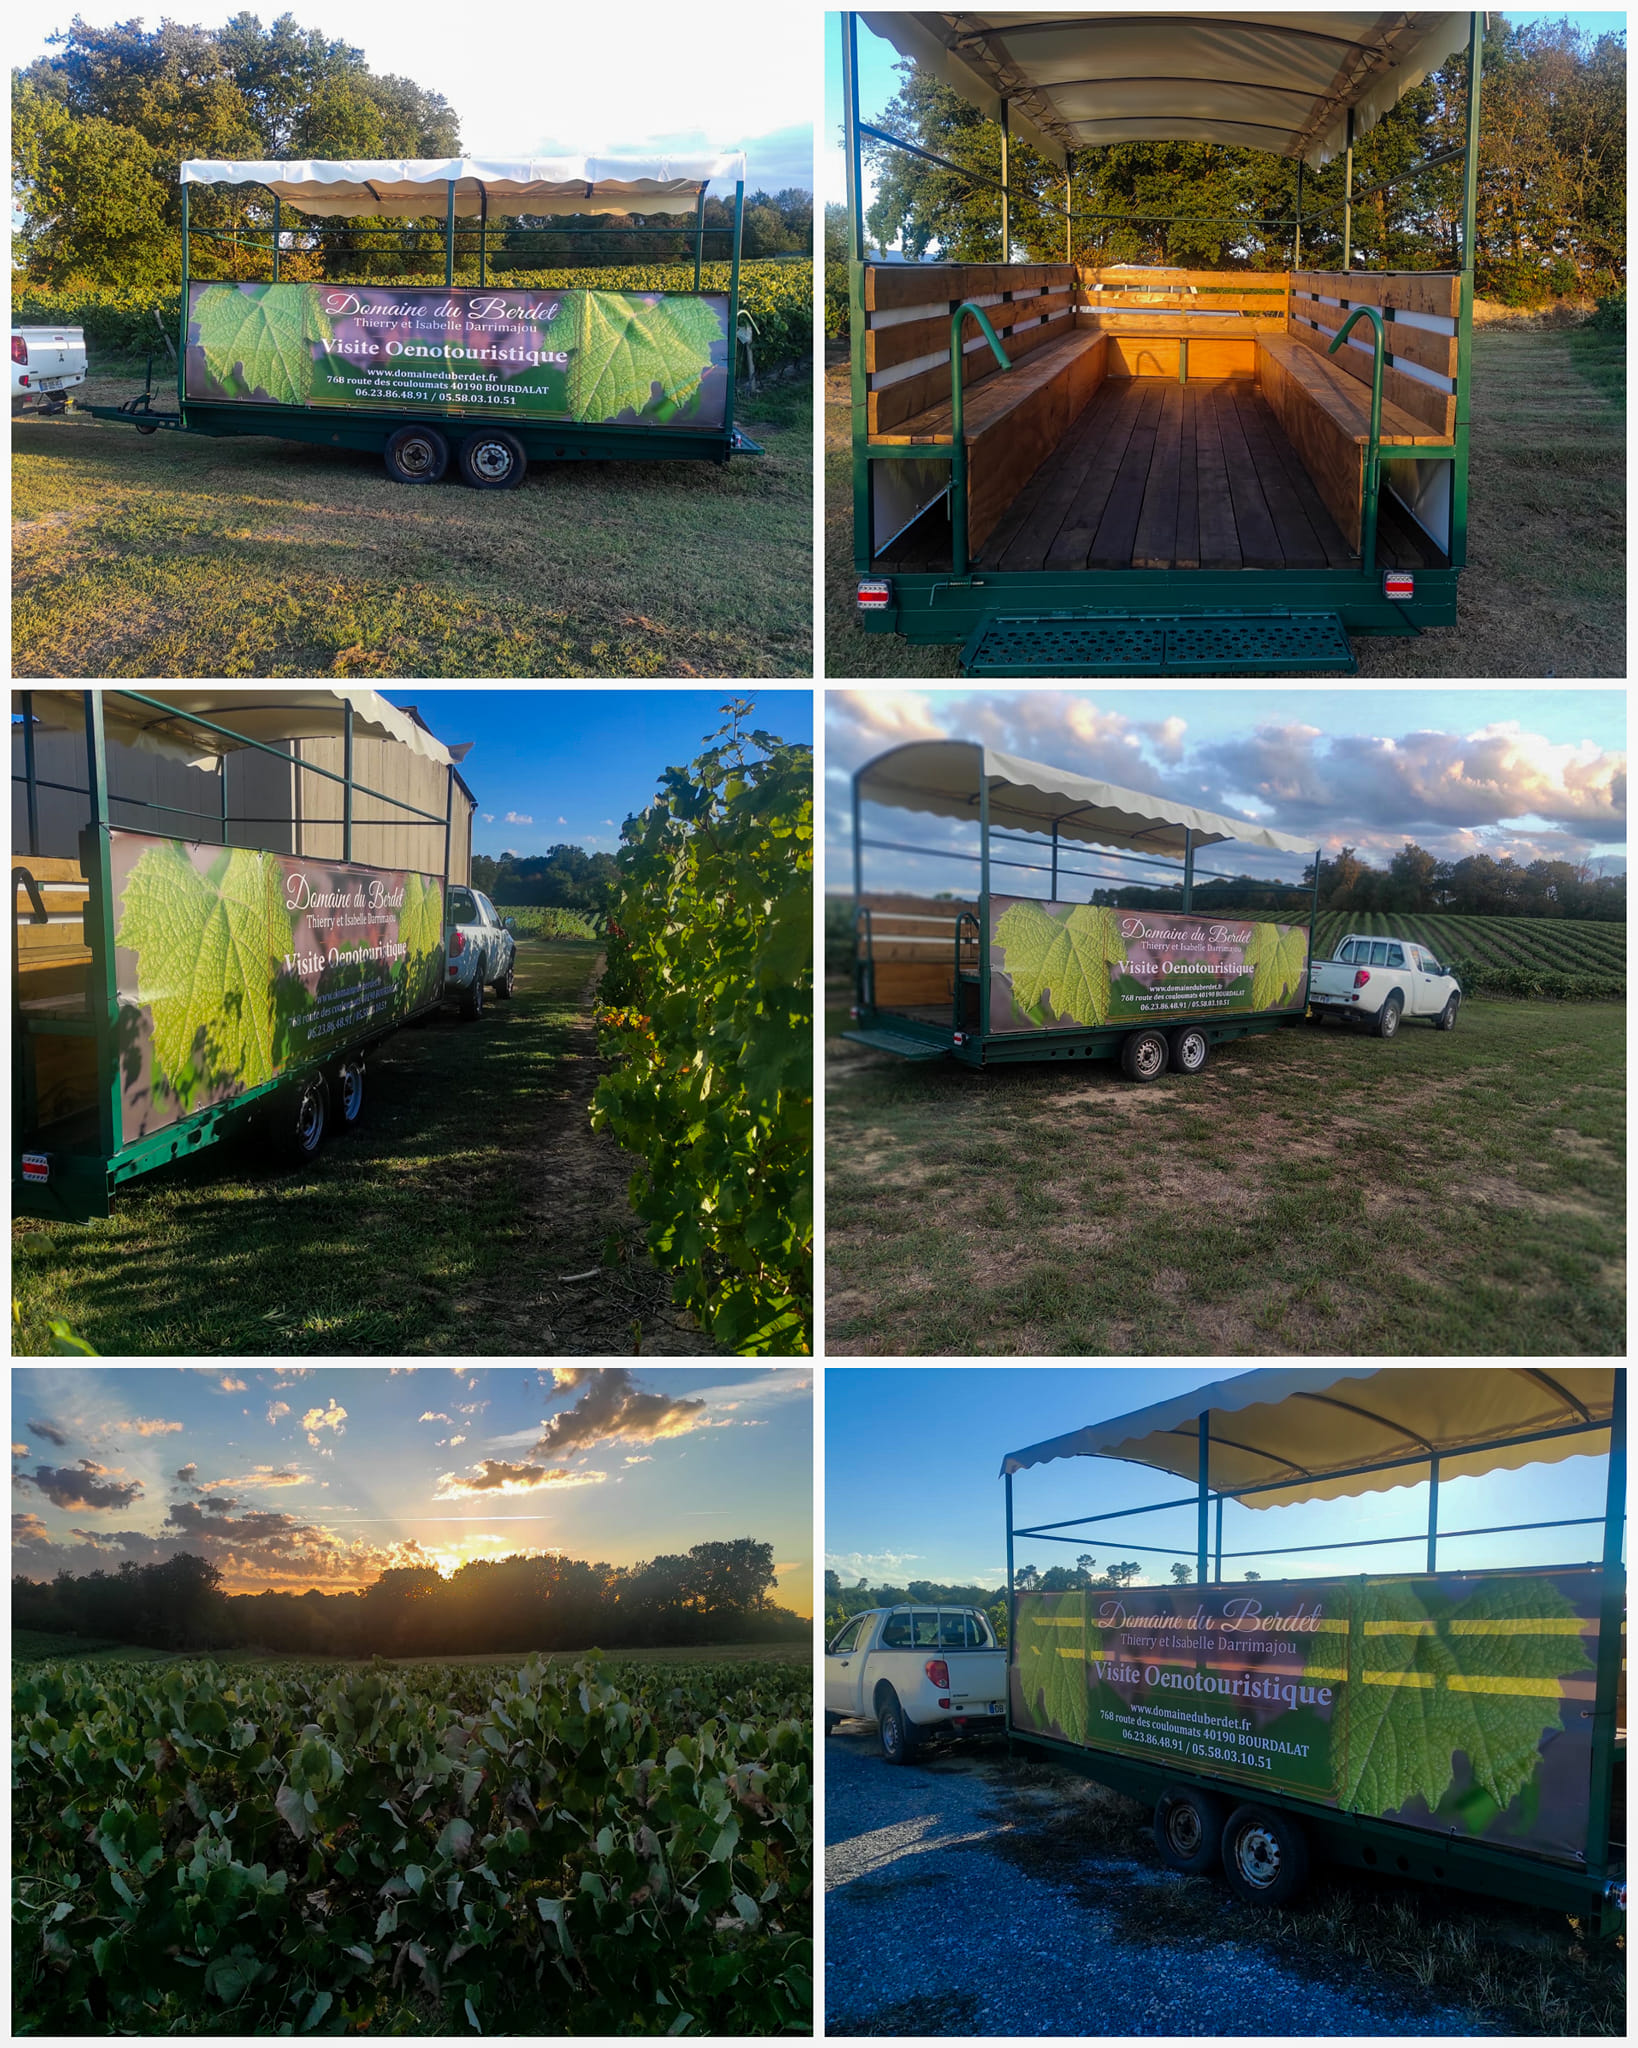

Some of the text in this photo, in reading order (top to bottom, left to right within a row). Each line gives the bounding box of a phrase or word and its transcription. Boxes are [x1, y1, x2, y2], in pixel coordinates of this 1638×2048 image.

[325, 293, 558, 320] Domaine du Berdet
[354, 318, 537, 334] Thierry et Isabelle Darrimajou
[321, 338, 568, 367] Visite Oenotouristique
[327, 376, 549, 395] 768 route des couloumats 40190 BOURDALAT
[367, 369, 498, 382] www.domaineduberdet.fr
[355, 388, 517, 405] 06.23.86.48.91 / 05.58.03.10.51
[286, 873, 351, 910] Domaine
[354, 884, 366, 909] du
[307, 914, 335, 930] Thierry
[336, 915, 344, 926] et
[344, 912, 367, 926] Isabelle
[1121, 918, 1252, 944] Domaine du Berdet
[1141, 941, 1169, 952] Thierry
[1180, 942, 1205, 952] Isabelle
[284, 951, 325, 976] Visite
[1118, 960, 1254, 977] Visite Oenotouristique
[1153, 992, 1164, 1000] des
[1098, 1597, 1322, 1632] Domaine du Berdet
[1120, 1633, 1297, 1656] Thierry et Isabelle Darrimajou
[1095, 1661, 1332, 1710] Visite Oenotouristique
[1130, 1704, 1251, 1731] www.domaineduberdet.fr
[1100, 1710, 1310, 1757] 768 route des couloumats 40190 BOURDALAT
[1122, 1729, 1272, 1770] 06.23.86.48.91 / 05.58.03.10.51
